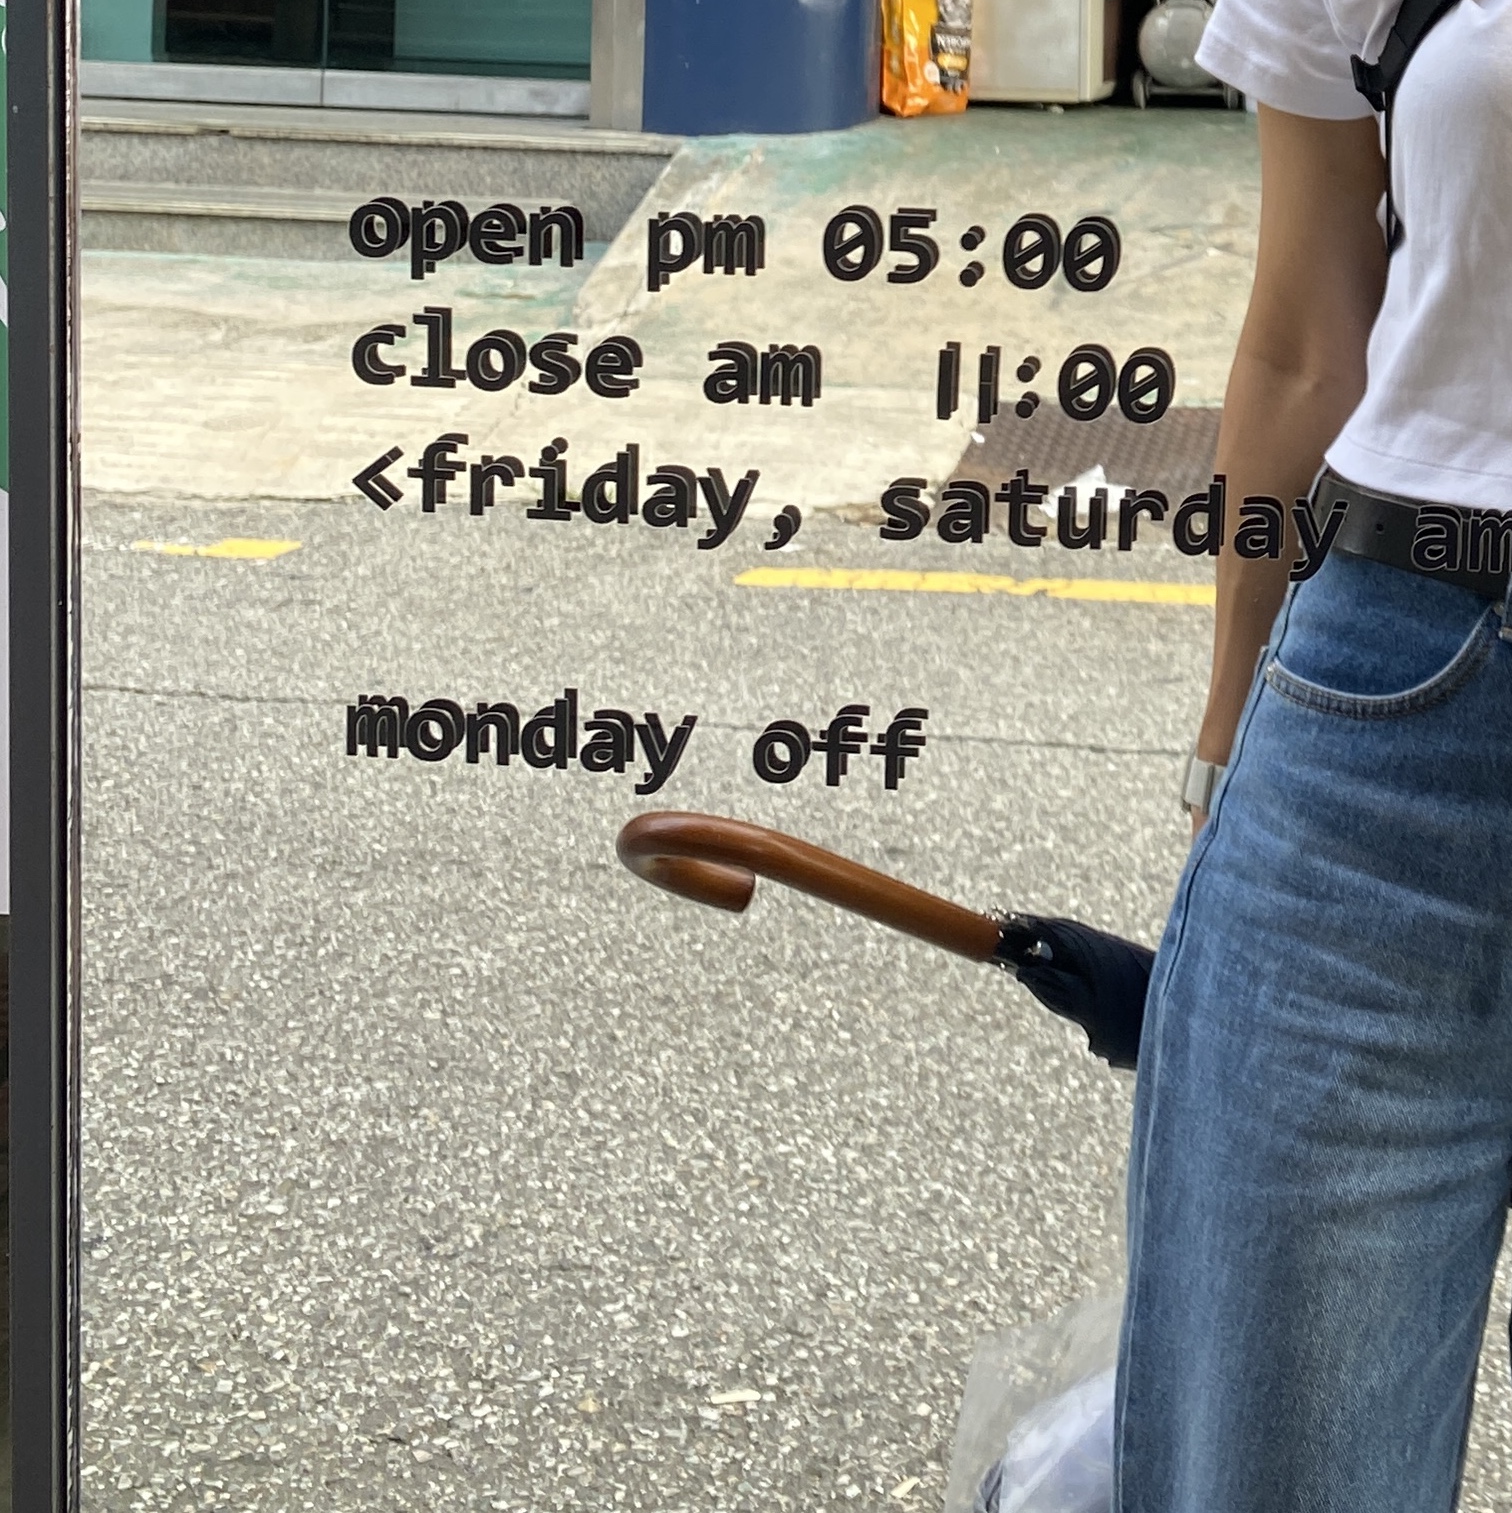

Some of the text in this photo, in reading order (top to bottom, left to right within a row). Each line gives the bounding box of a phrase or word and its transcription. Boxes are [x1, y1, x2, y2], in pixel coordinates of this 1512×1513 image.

[349, 196, 1122, 293] open pm 05:00
[351, 305, 1176, 424] close am 11:00
[351, 433, 803, 552] <friday,
[879, 468, 1348, 582] saturday
[346, 688, 929, 796] monday off
